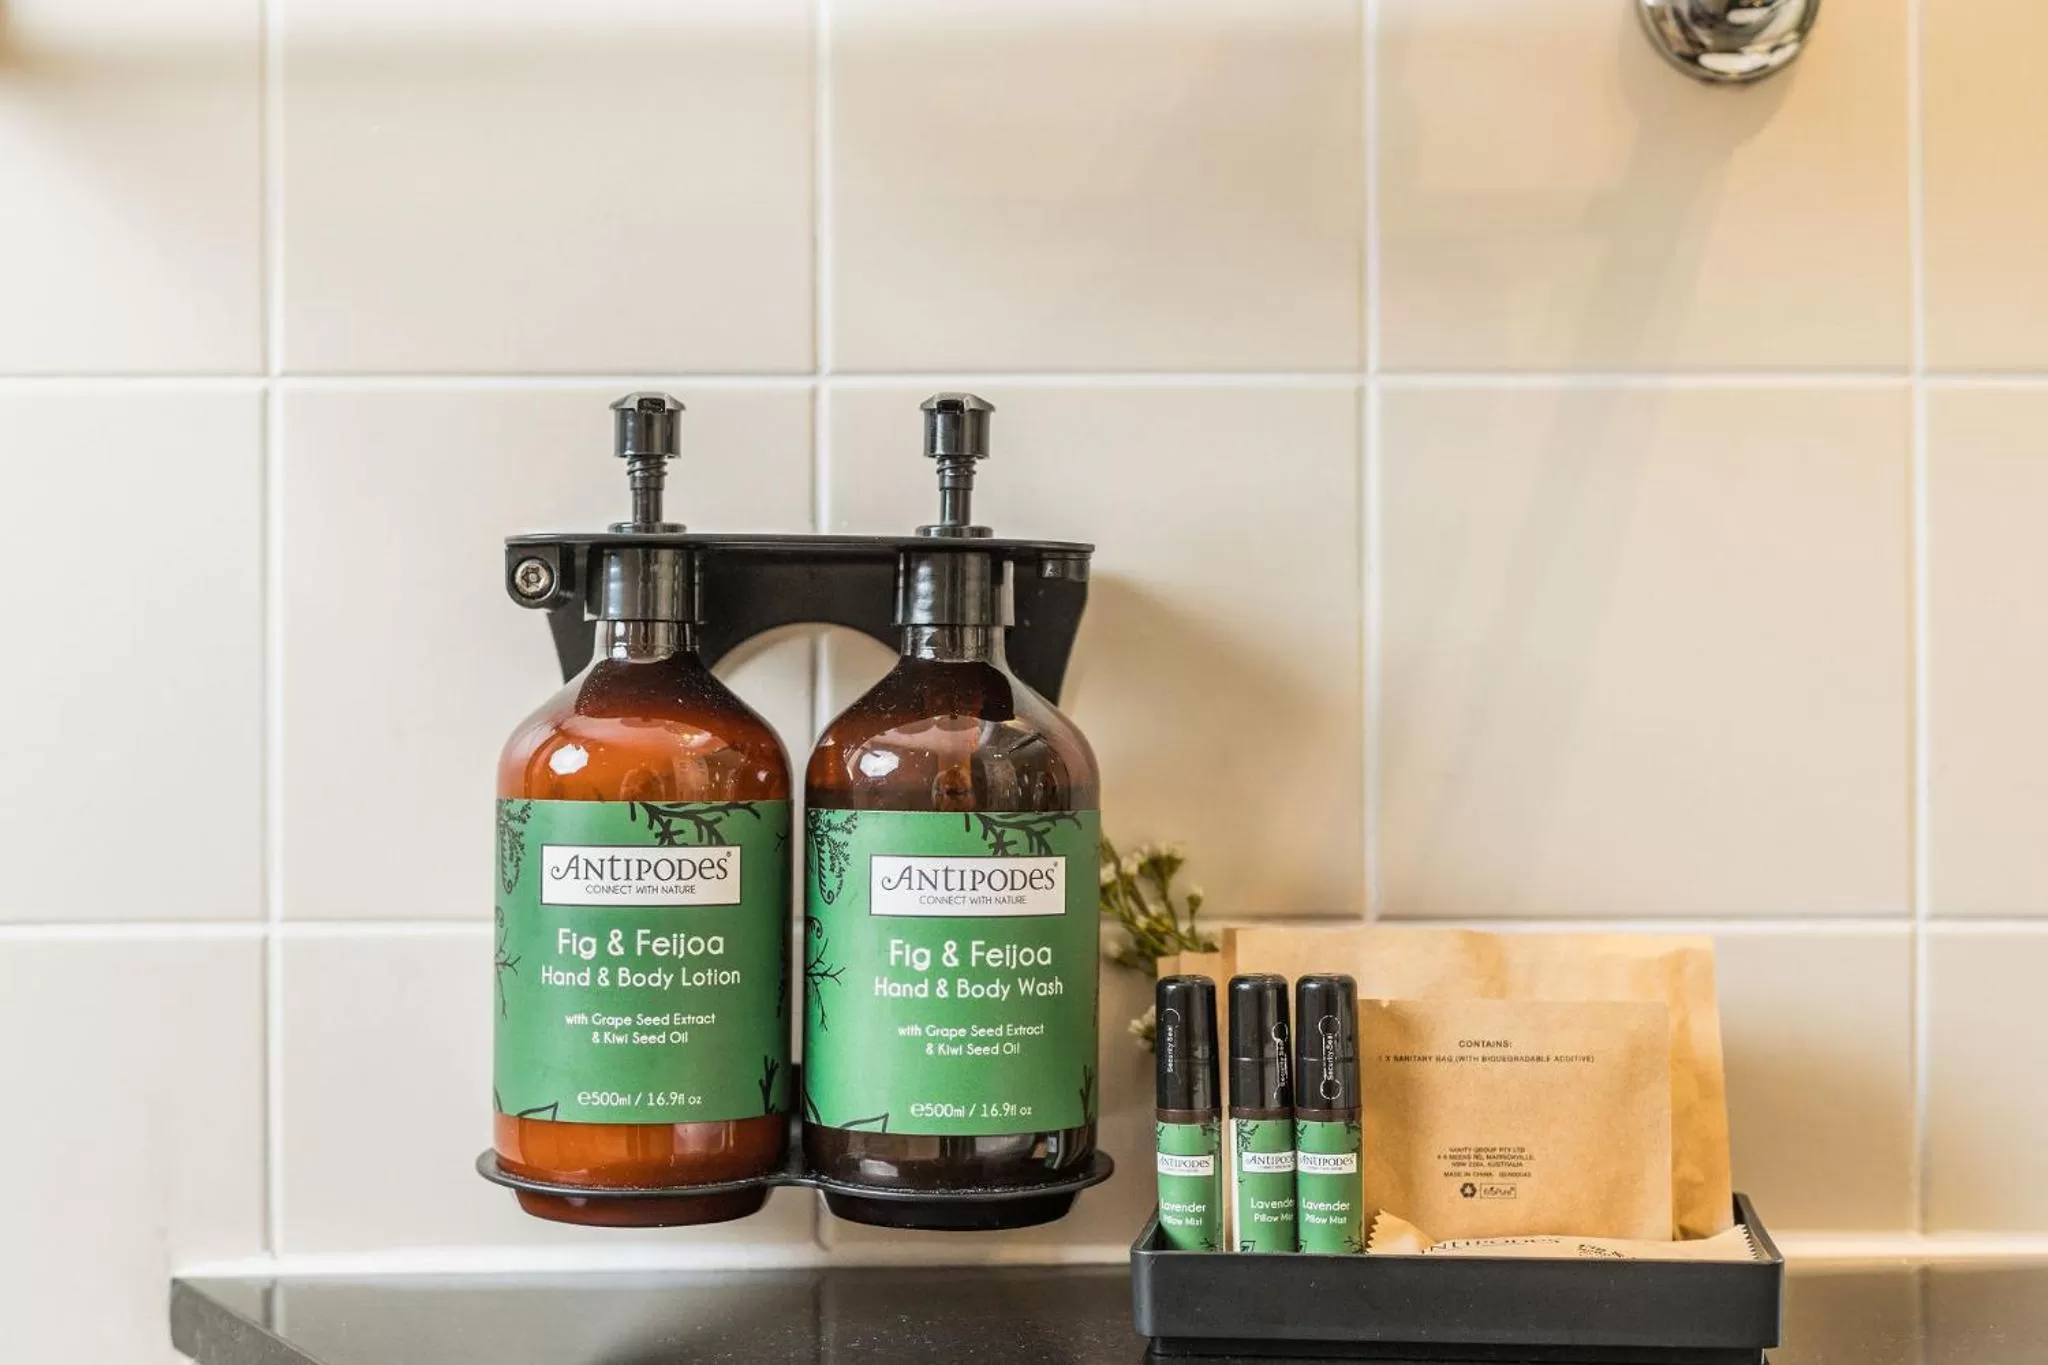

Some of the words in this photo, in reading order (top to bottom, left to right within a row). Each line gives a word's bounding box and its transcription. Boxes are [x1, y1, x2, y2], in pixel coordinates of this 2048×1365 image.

[585, 884, 632, 895] CONNECT
[636, 884, 659, 895] WITH
[661, 884, 696, 894] NATURE
[919, 895, 965, 905] CONNECT
[969, 896, 992, 905] WITH
[994, 895, 1027, 904] NATURE
[557, 928, 597, 960] Fig
[607, 929, 624, 956] &
[636, 929, 725, 959] Feijoa
[889, 939, 931, 971] Fig
[942, 940, 959, 967] &
[971, 940, 1052, 970] Feijoa
[541, 965, 590, 986] Hand
[597, 967, 610, 986] &
[618, 967, 674, 990] Body
[681, 967, 741, 986] Lotion
[874, 976, 928, 997] Hand
[936, 978, 949, 997] &
[957, 978, 1011, 1001] Body
[1017, 976, 1063, 996] Wash
[565, 1013, 588, 1025] with
[591, 1013, 632, 1029] Grape
[636, 1013, 670, 1026] Seed
[673, 1012, 716, 1025] Extract
[591, 1032, 600, 1044] &
[604, 1032, 628, 1044] Kiwi
[632, 1032, 666, 1044] Seed
[670, 1031, 689, 1044] Oil
[897, 1025, 922, 1037] with
[925, 1024, 967, 1040] Grape
[970, 1024, 1003, 1037] Seed
[1006, 1024, 1044, 1036] Extract
[926, 1043, 934, 1055] &
[938, 1043, 963, 1055] Kiwi
[967, 1043, 1000, 1055] Seed
[1002, 1042, 1020, 1055] Oil
[1458, 1039, 1513, 1049] CONTAINS:
[1393, 1055, 1433, 1063] SANITARY
[634, 1092, 643, 1106] /
[647, 1091, 685, 1106] 16.9fl
[688, 1095, 702, 1105] oz
[968, 1104, 977, 1117] /
[981, 1102, 1017, 1117] 16.9fl
[1019, 1105, 1032, 1116] oz
[1161, 1197, 1206, 1212] Lavender
[1302, 1196, 1350, 1211] Lavender
